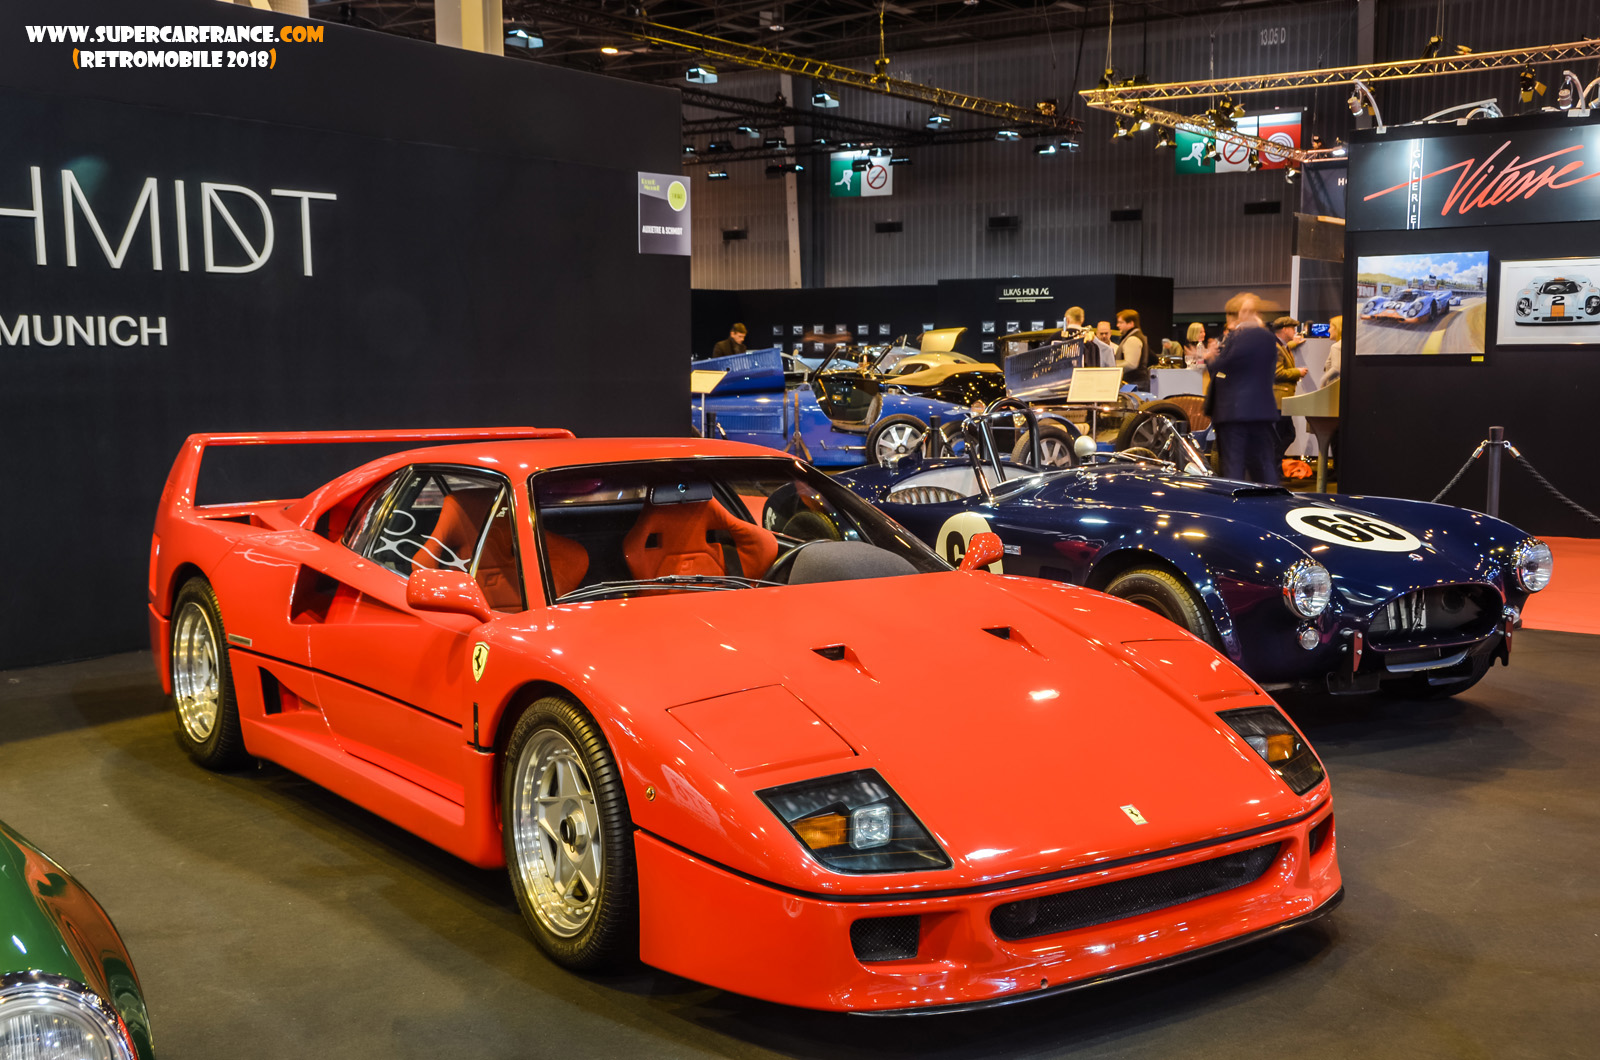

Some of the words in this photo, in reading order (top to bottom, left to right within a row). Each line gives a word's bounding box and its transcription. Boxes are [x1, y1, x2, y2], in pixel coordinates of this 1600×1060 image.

[1260, 28, 1278, 45] 13.05
[1280, 27, 1286, 43] D
[1410, 149, 1421, 224] GALERIE
[1438, 140, 1586, 217] Vitesse
[1003, 288, 1021, 296] LUKAS
[1040, 287, 1049, 295] AG
[1552, 295, 1565, 306] 2
[0, 314, 168, 346] MUNICH
[1300, 513, 1407, 542] 66
